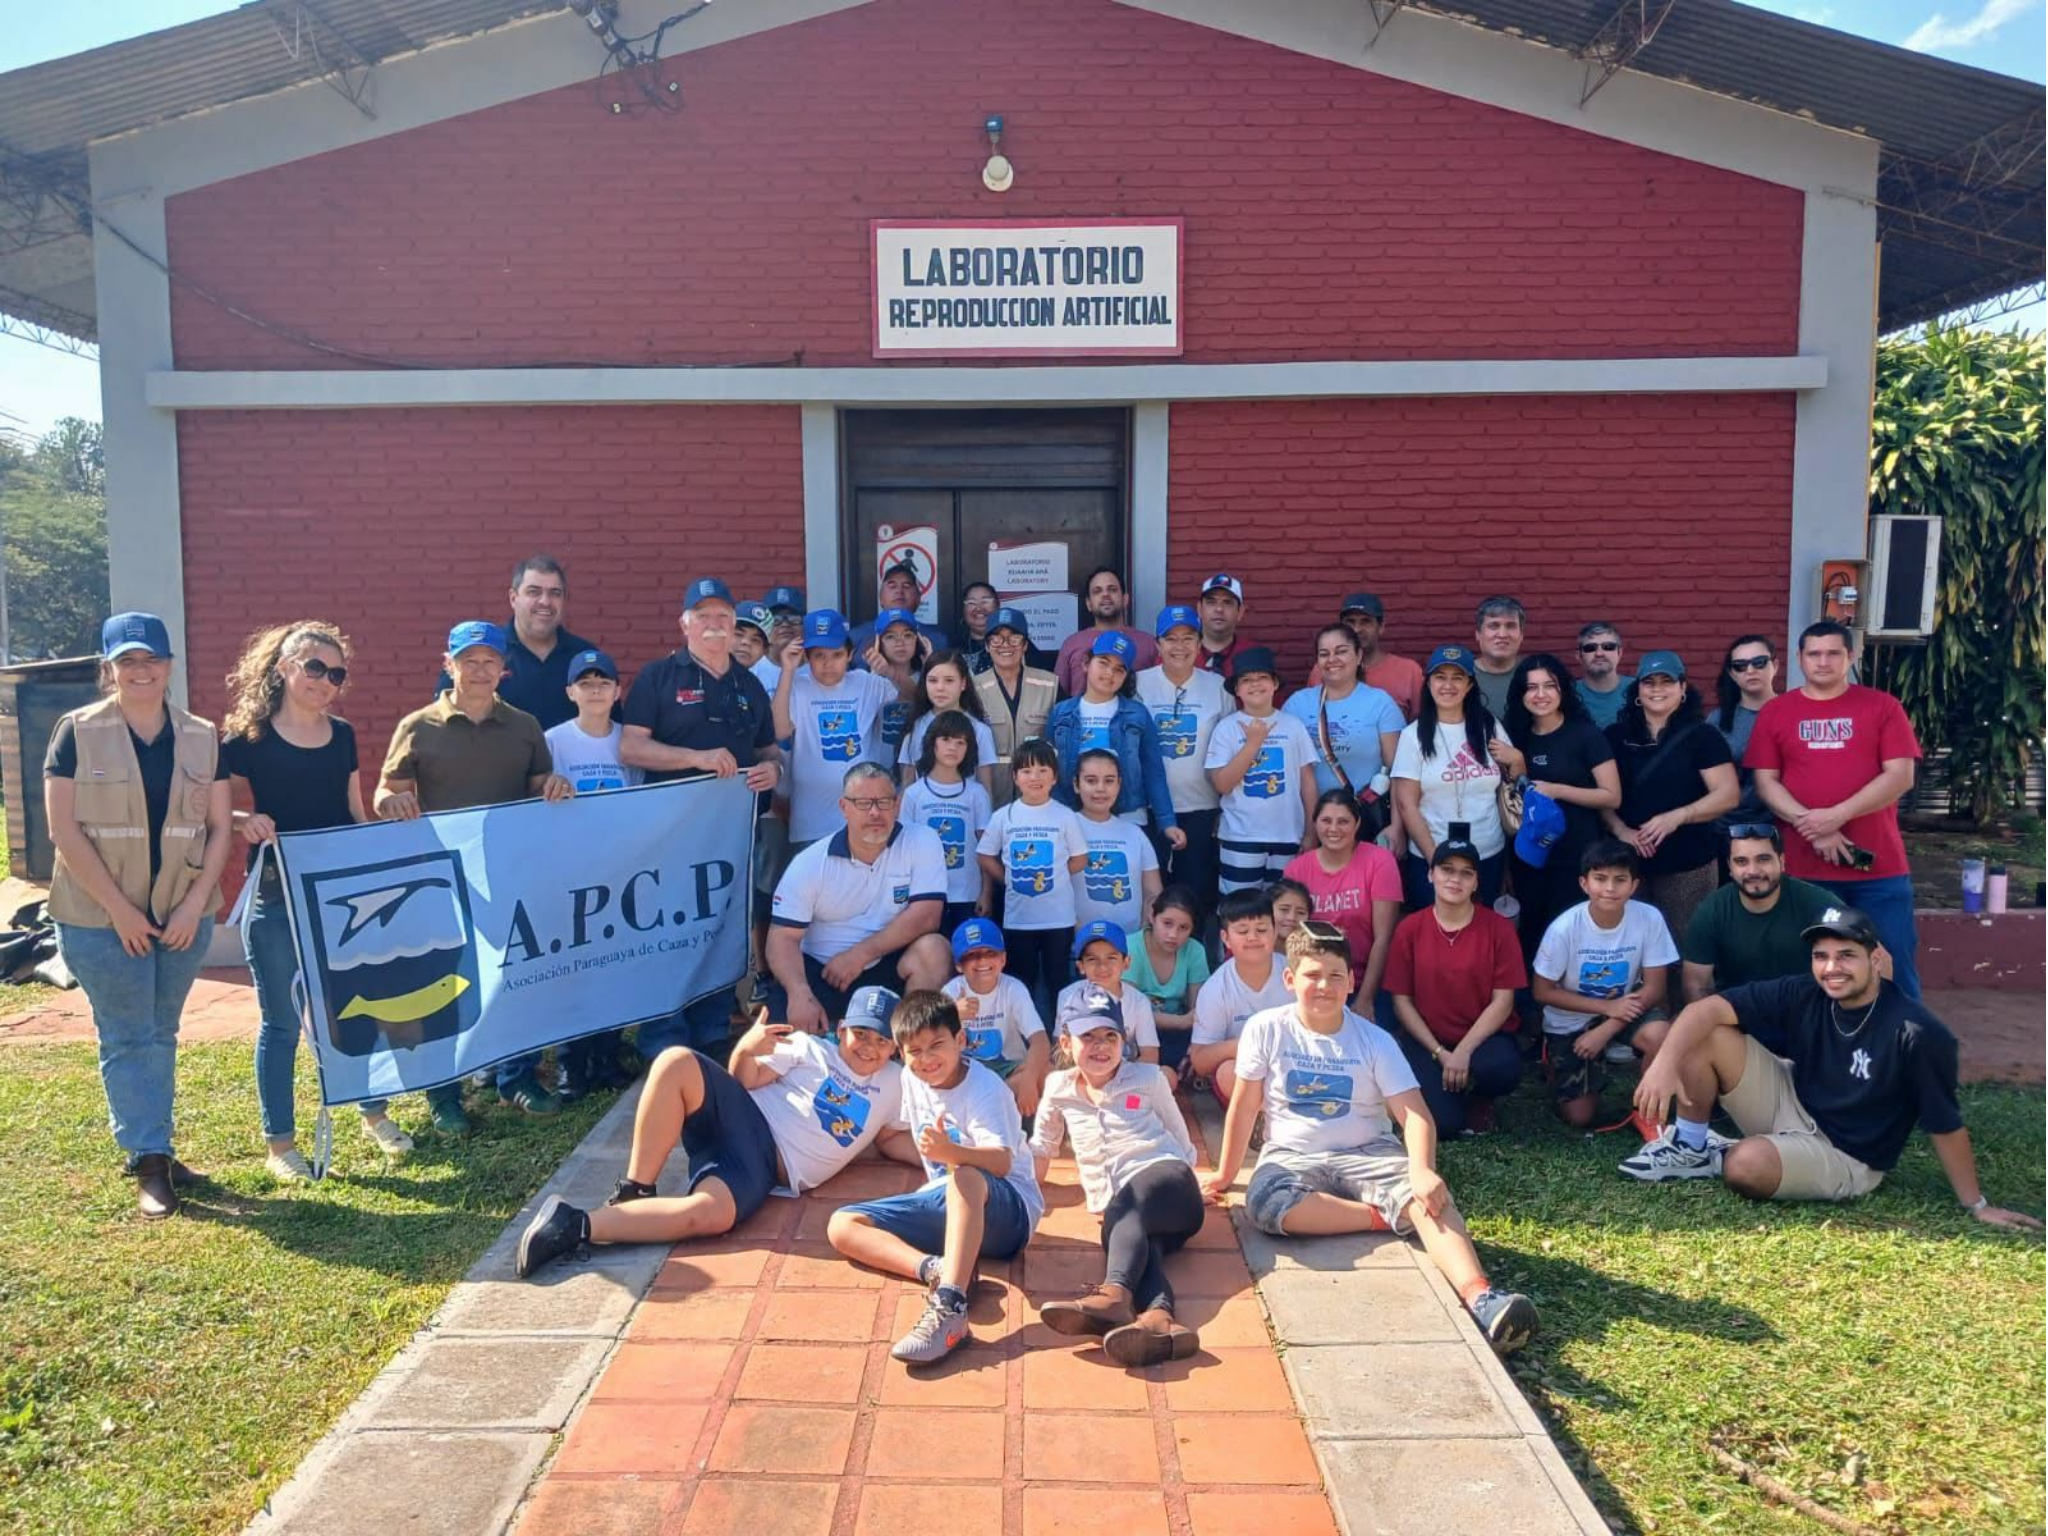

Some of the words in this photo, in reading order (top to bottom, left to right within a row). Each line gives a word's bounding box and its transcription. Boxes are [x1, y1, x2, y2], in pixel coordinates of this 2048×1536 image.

[902, 246, 1144, 287] LABORATORIO
[889, 297, 1055, 328] REPRODUCCION
[1062, 295, 1172, 327] ARTIFICIAL
[1799, 718, 1852, 741] GUNS
[1441, 767, 1500, 782] adidas
[503, 962, 571, 993] Asociación
[573, 948, 636, 973] Paraguaya
[638, 942, 655, 957] de
[657, 937, 690, 954] Caza
[690, 937, 699, 950] y
[1850, 1048, 1872, 1080] NY
